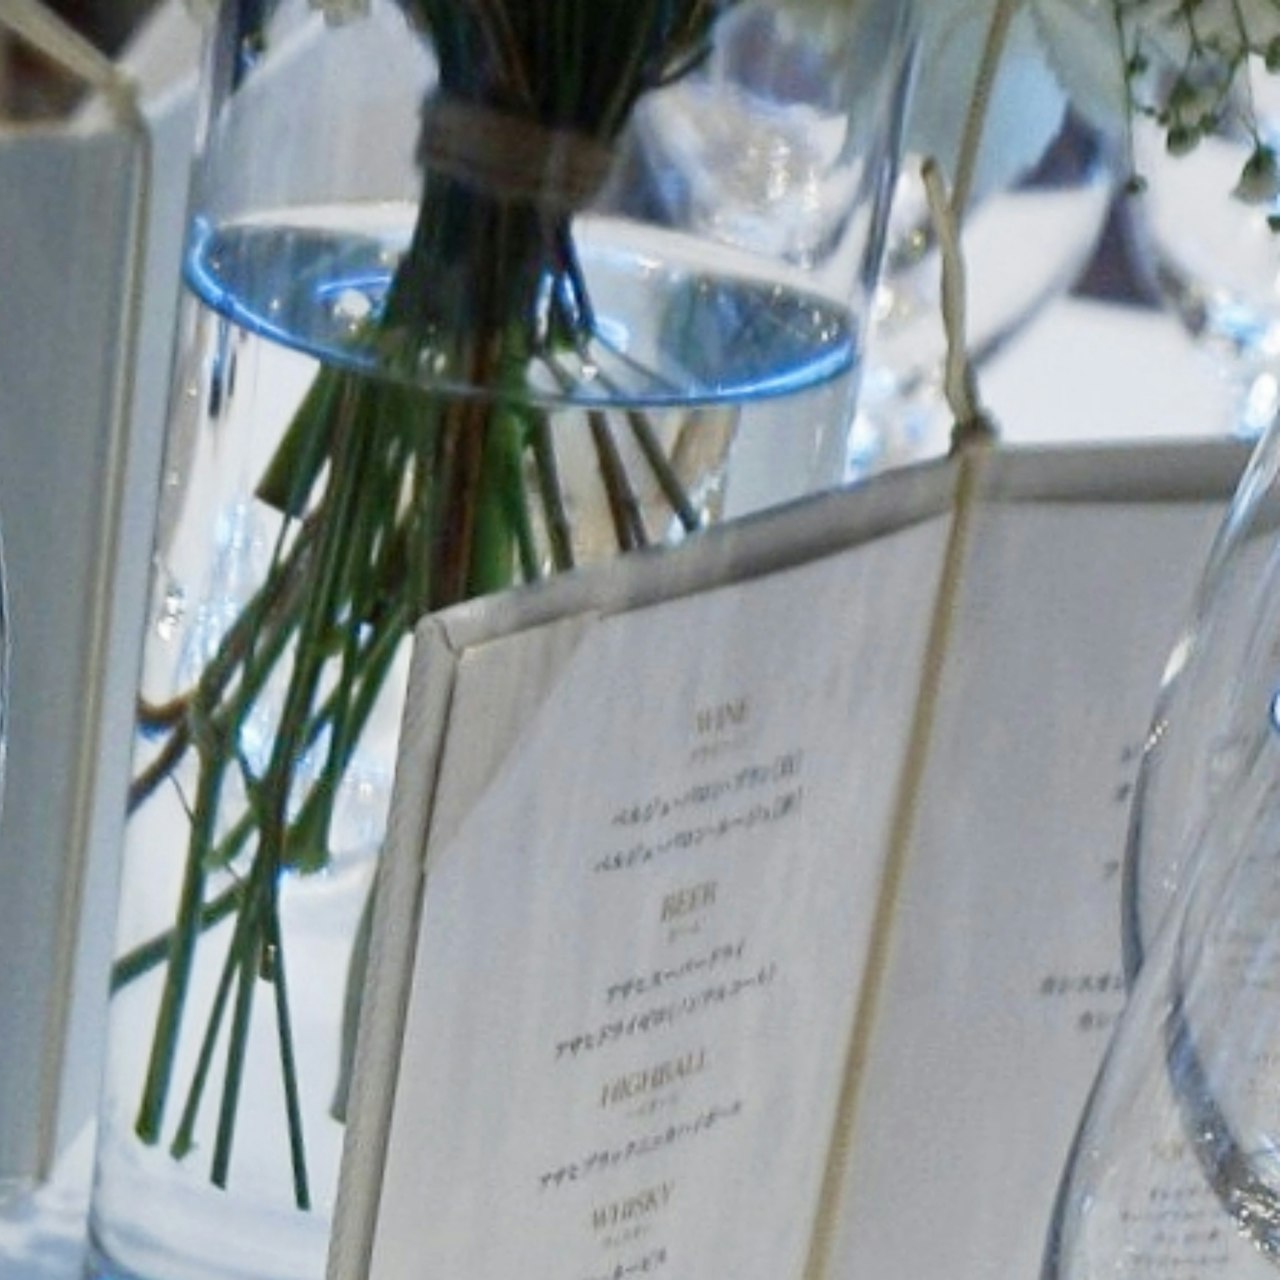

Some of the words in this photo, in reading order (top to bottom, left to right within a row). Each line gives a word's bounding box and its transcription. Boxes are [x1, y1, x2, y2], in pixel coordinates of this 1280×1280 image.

[660, 882, 717, 921] BEER
[600, 1048, 706, 1107] HIGHBALL
[592, 1181, 675, 1229] WHISKY
